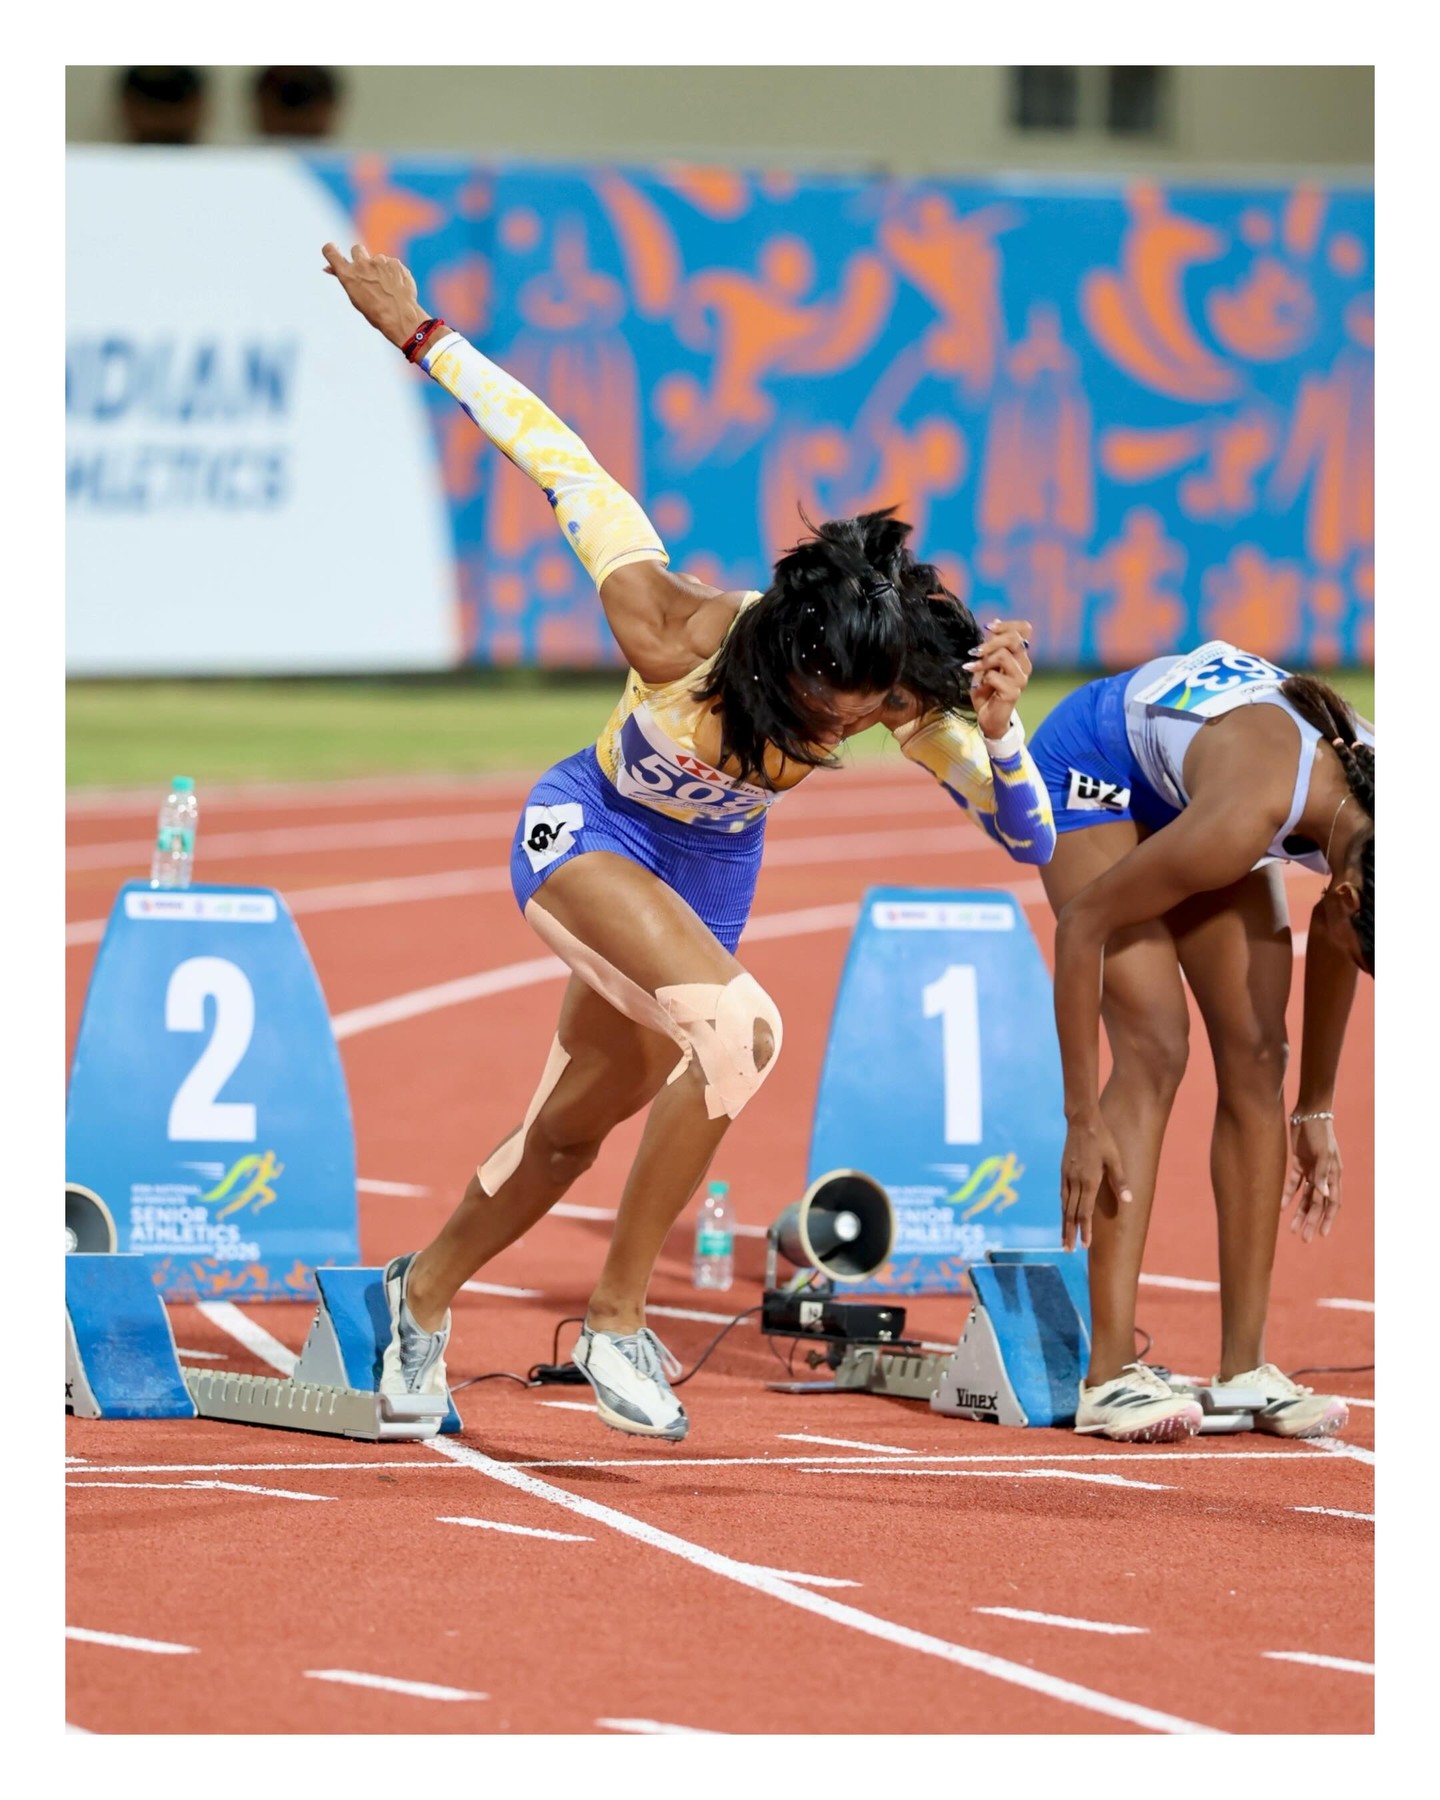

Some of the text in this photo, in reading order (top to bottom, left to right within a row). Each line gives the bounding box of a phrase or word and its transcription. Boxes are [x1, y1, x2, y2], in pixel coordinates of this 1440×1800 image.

[1185, 655, 1278, 691] 63
[165, 955, 257, 1142] 2
[922, 964, 983, 1146] 1
[131, 1206, 208, 1224] SENIOR
[895, 1207, 954, 1224] ENIOR
[131, 1224, 240, 1243] ATHLETICS
[895, 1224, 985, 1243] THLETICS
[956, 1387, 998, 1411] Vinex
